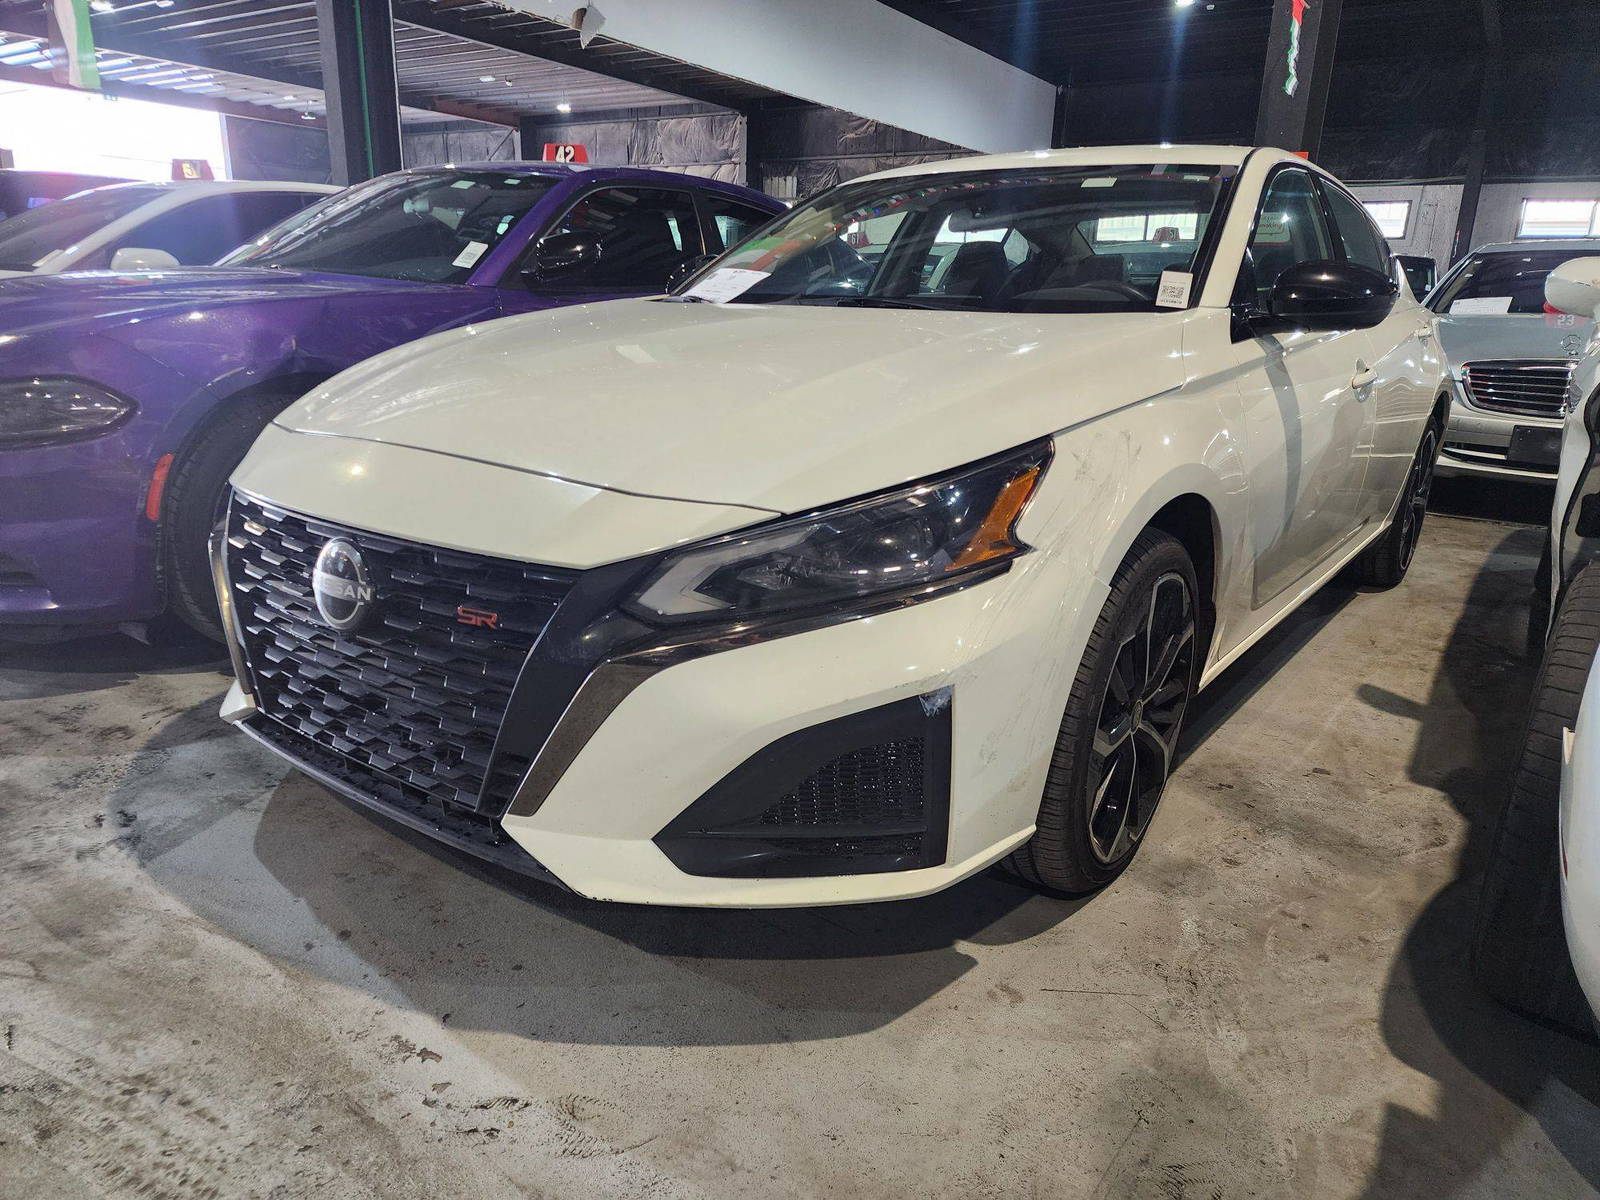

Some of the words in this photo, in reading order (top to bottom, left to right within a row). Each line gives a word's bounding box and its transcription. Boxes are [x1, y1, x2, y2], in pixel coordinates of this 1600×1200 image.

[555, 145, 575, 163] 42
[1557, 314, 1575, 326] 23
[457, 606, 498, 630] SR
